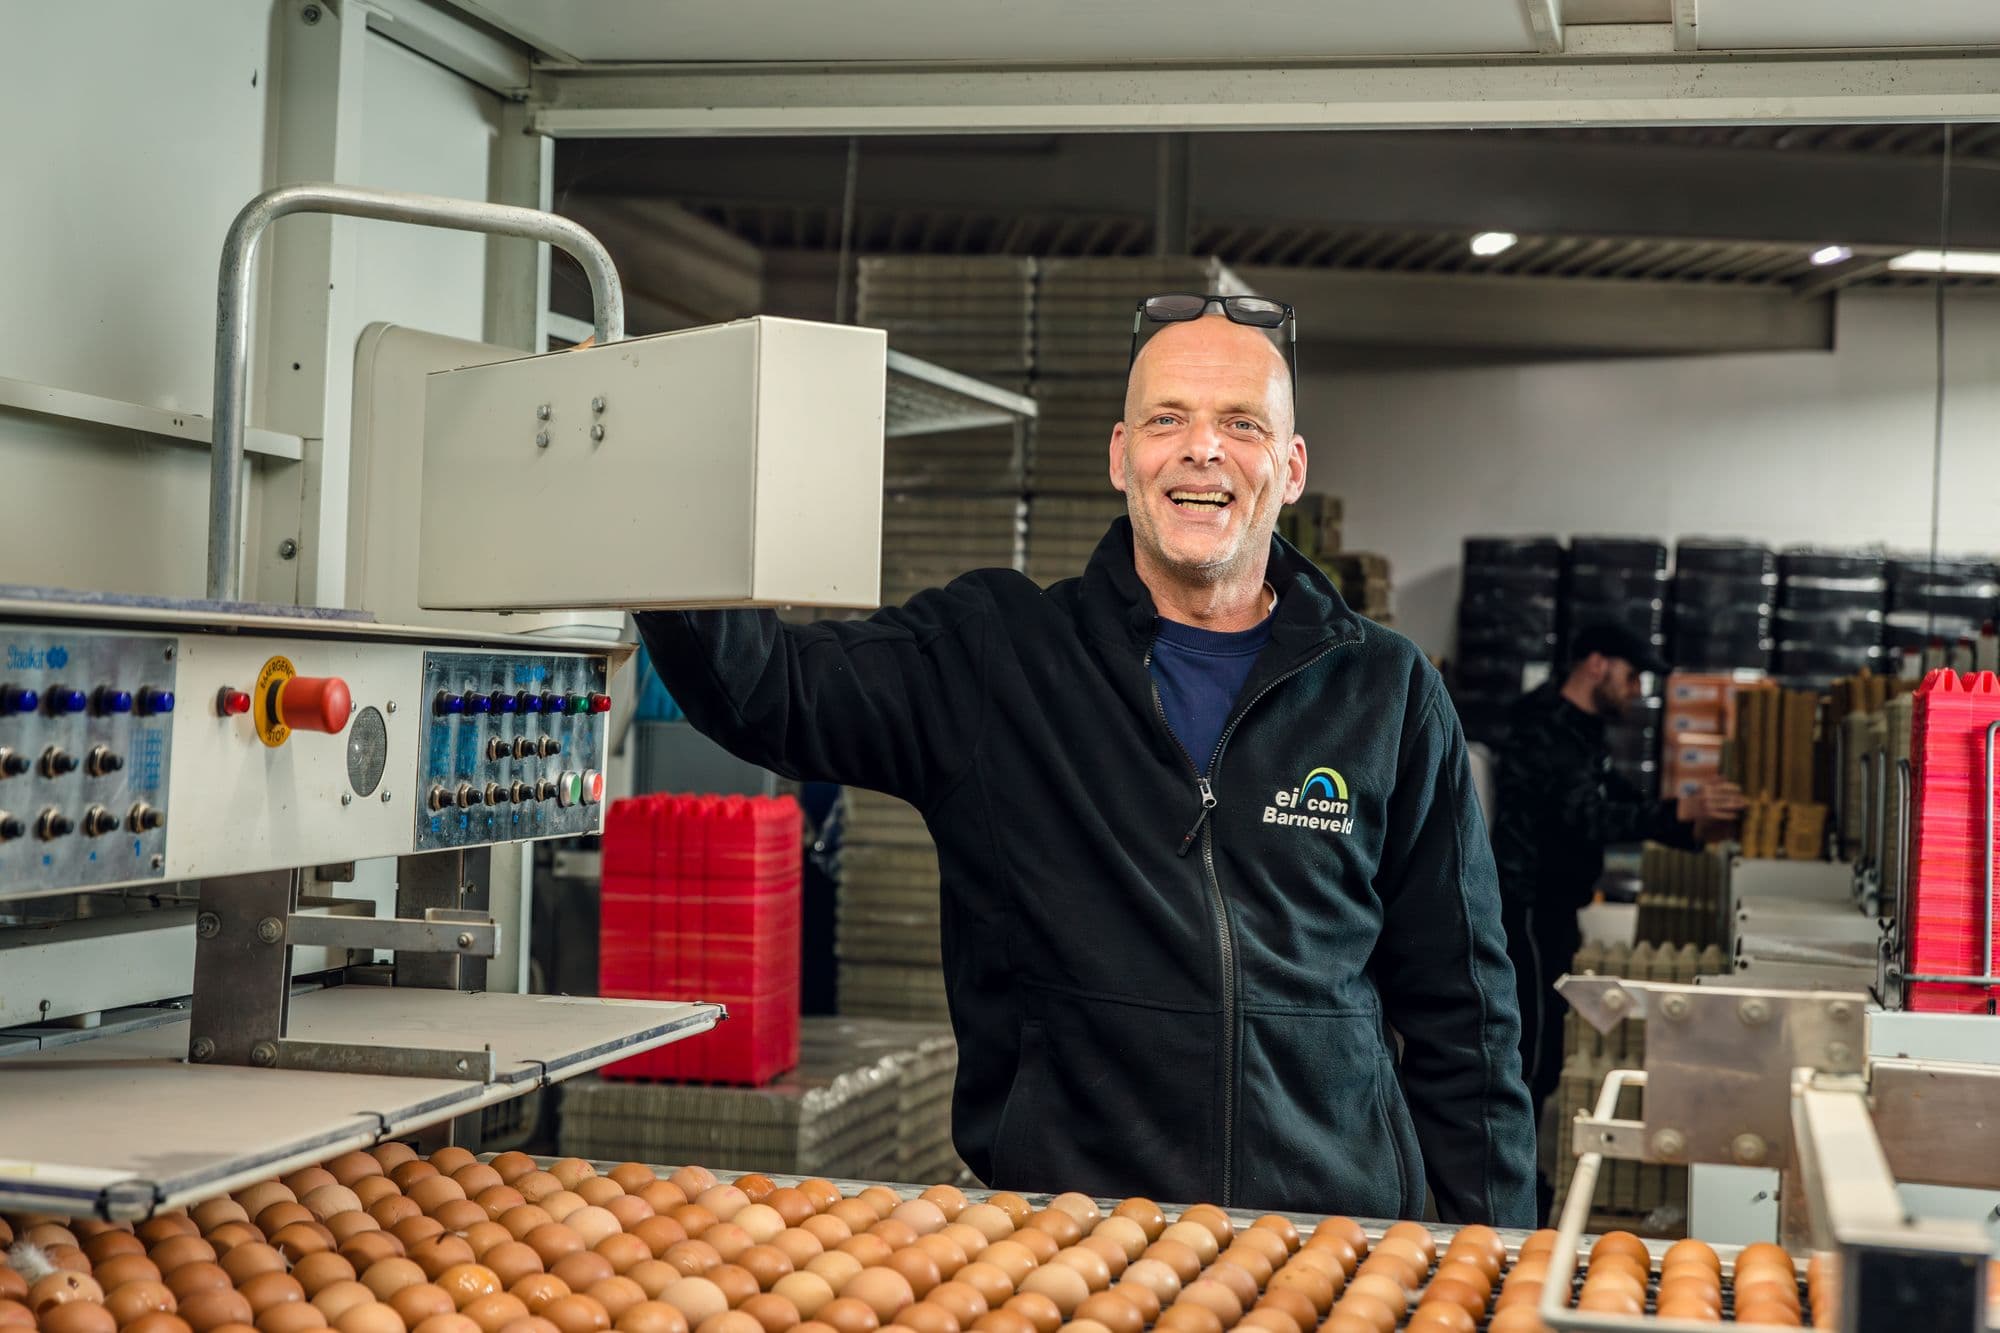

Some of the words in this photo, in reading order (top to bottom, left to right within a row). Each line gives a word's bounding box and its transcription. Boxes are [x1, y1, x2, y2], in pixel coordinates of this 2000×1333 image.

[260, 660, 294, 689] EMERGENC
[268, 727, 286, 742] STOP
[1275, 788, 1300, 808] ei
[1307, 798, 1349, 814] com
[1262, 806, 1354, 834] Barneveld
